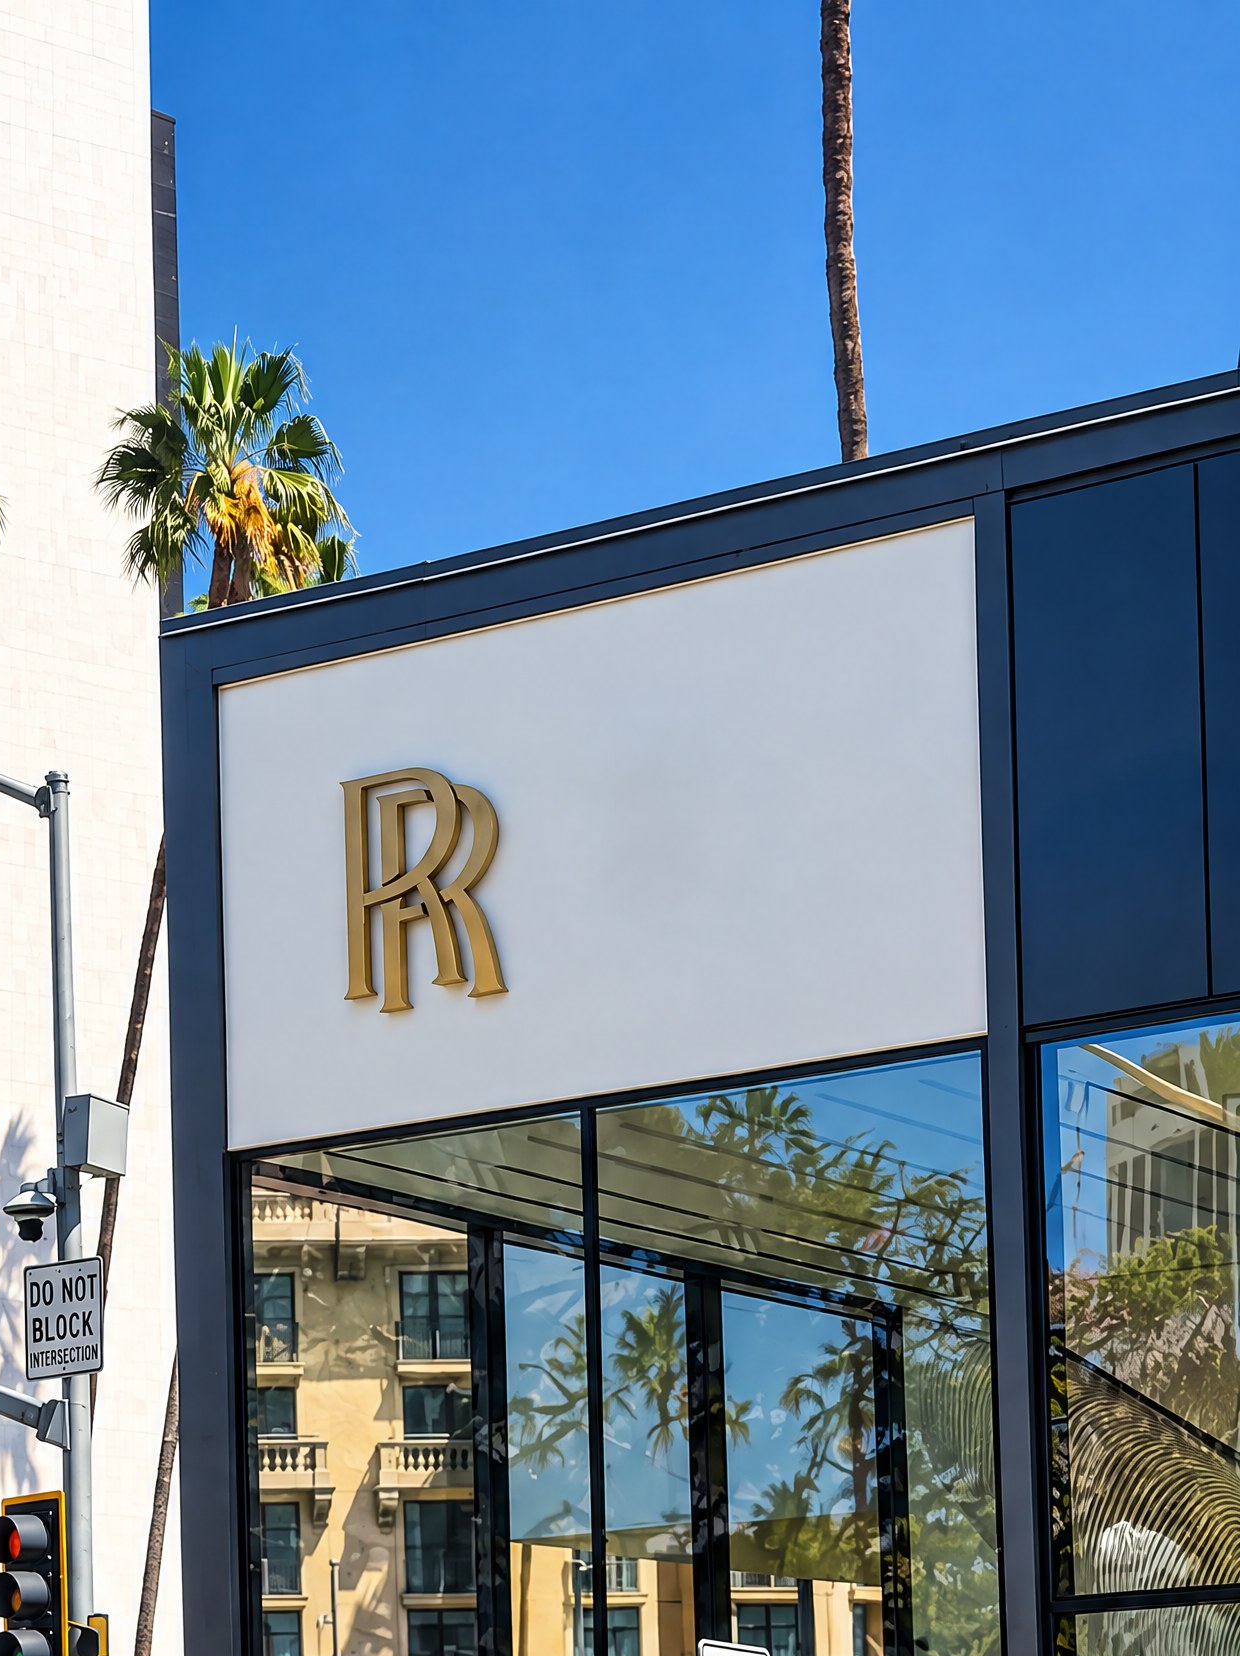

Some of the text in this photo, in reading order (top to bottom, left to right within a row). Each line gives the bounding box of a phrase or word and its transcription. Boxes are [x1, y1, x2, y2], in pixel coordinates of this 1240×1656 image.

[30, 1274, 97, 1308] DO NOT
[32, 1310, 94, 1343] BLOCK
[30, 1344, 98, 1368] INTERSECTION
